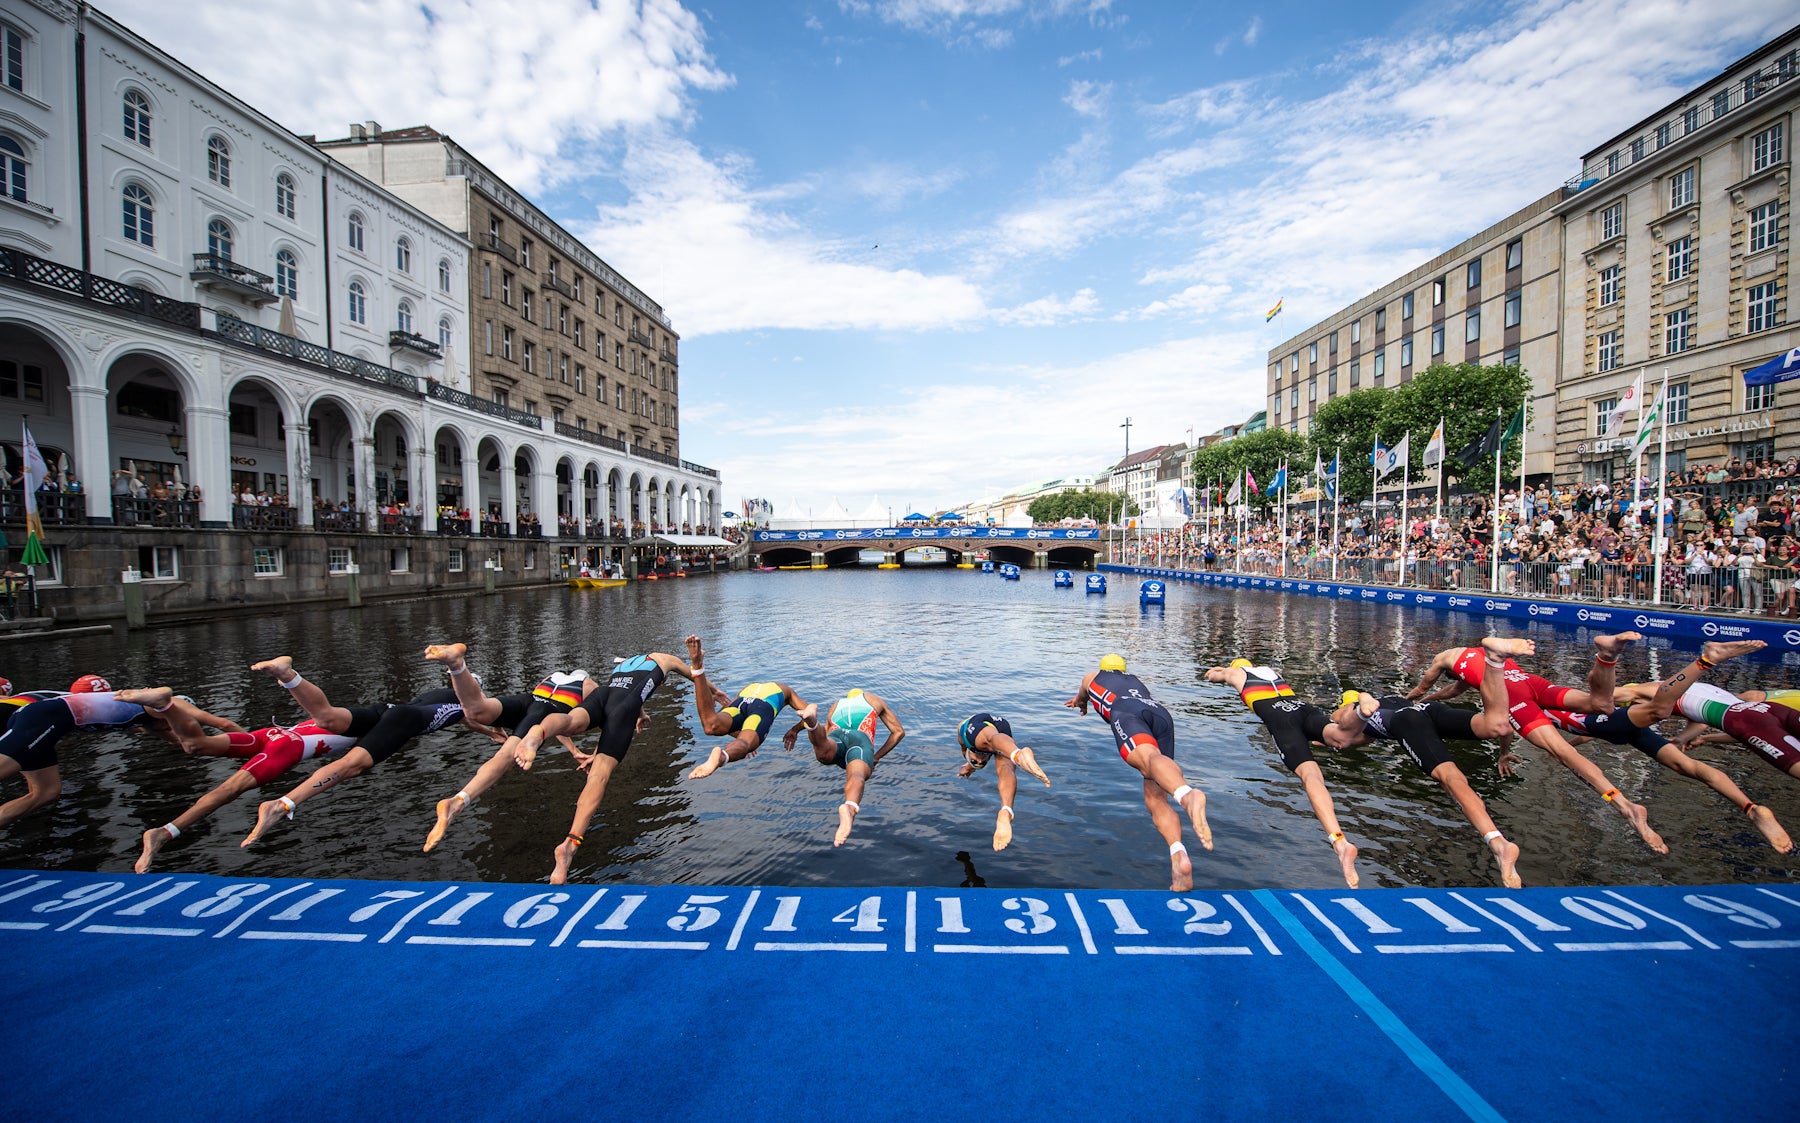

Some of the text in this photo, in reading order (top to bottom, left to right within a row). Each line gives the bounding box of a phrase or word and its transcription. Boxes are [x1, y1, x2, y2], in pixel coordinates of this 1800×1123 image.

[1658, 431, 1692, 443] ANK
[231, 456, 256, 466] NGO
[1720, 625, 1750, 634] HAMBURG
[90, 679, 111, 692] 23
[0, 879, 125, 913] 19
[113, 881, 270, 918] 18
[269, 888, 424, 923] 17
[428, 892, 571, 929] 16
[595, 895, 729, 932] 15
[1485, 896, 1647, 931] 10
[1683, 894, 1781, 929] 9
[763, 896, 887, 932] 14
[934, 897, 1056, 935] 13
[1098, 898, 1232, 937] 12
[1331, 897, 1481, 934] 11
